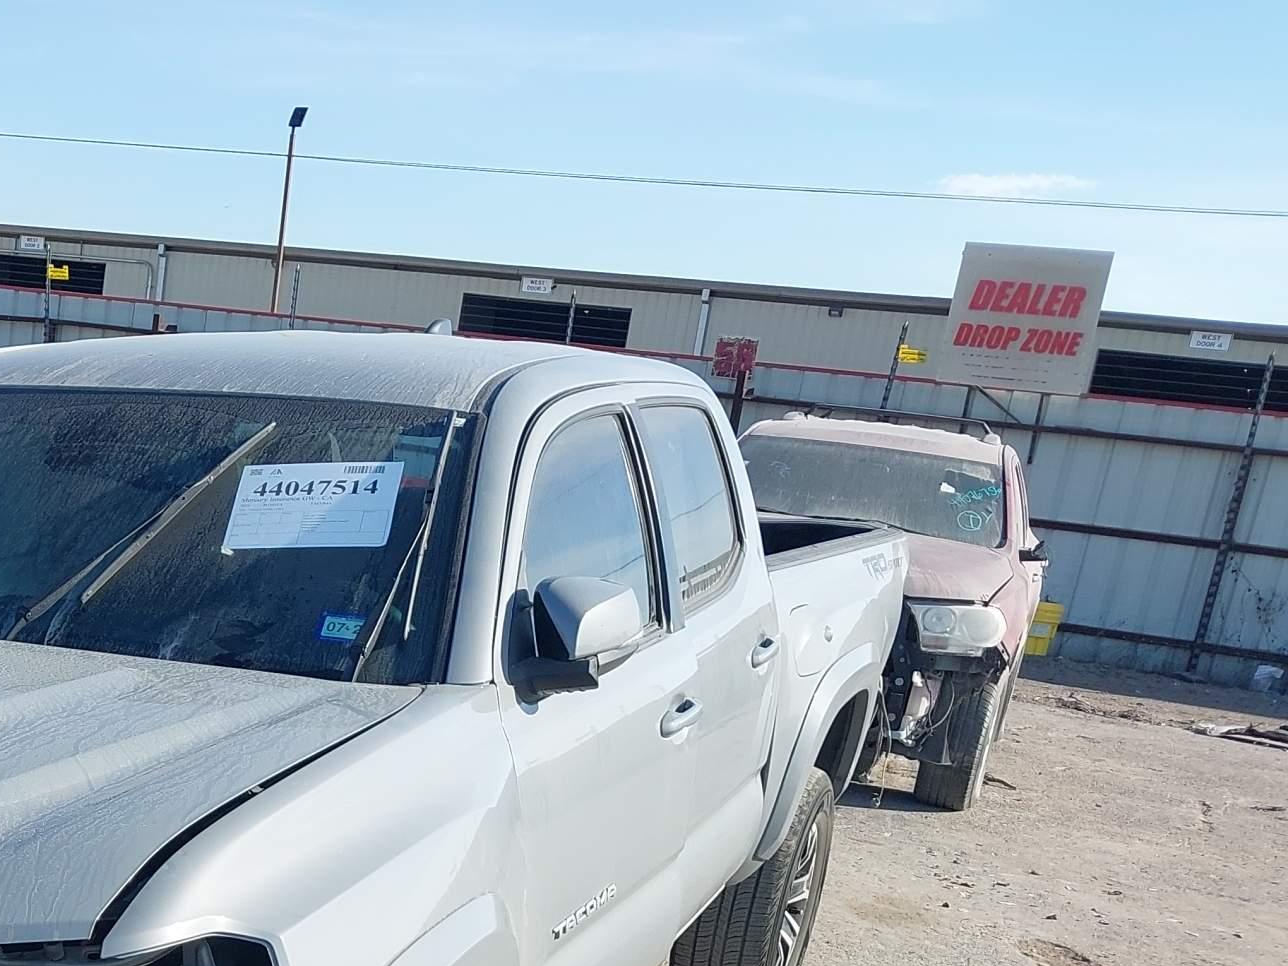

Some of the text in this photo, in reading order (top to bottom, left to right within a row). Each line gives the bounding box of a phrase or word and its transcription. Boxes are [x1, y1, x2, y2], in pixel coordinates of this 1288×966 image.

[968, 279, 1087, 319] DEALER
[953, 322, 1084, 357] DROP ZONE
[1196, 340, 1215, 348] DOOR
[253, 479, 378, 497] 44047514
[862, 552, 888, 581] TRD
[326, 621, 346, 633] 07
